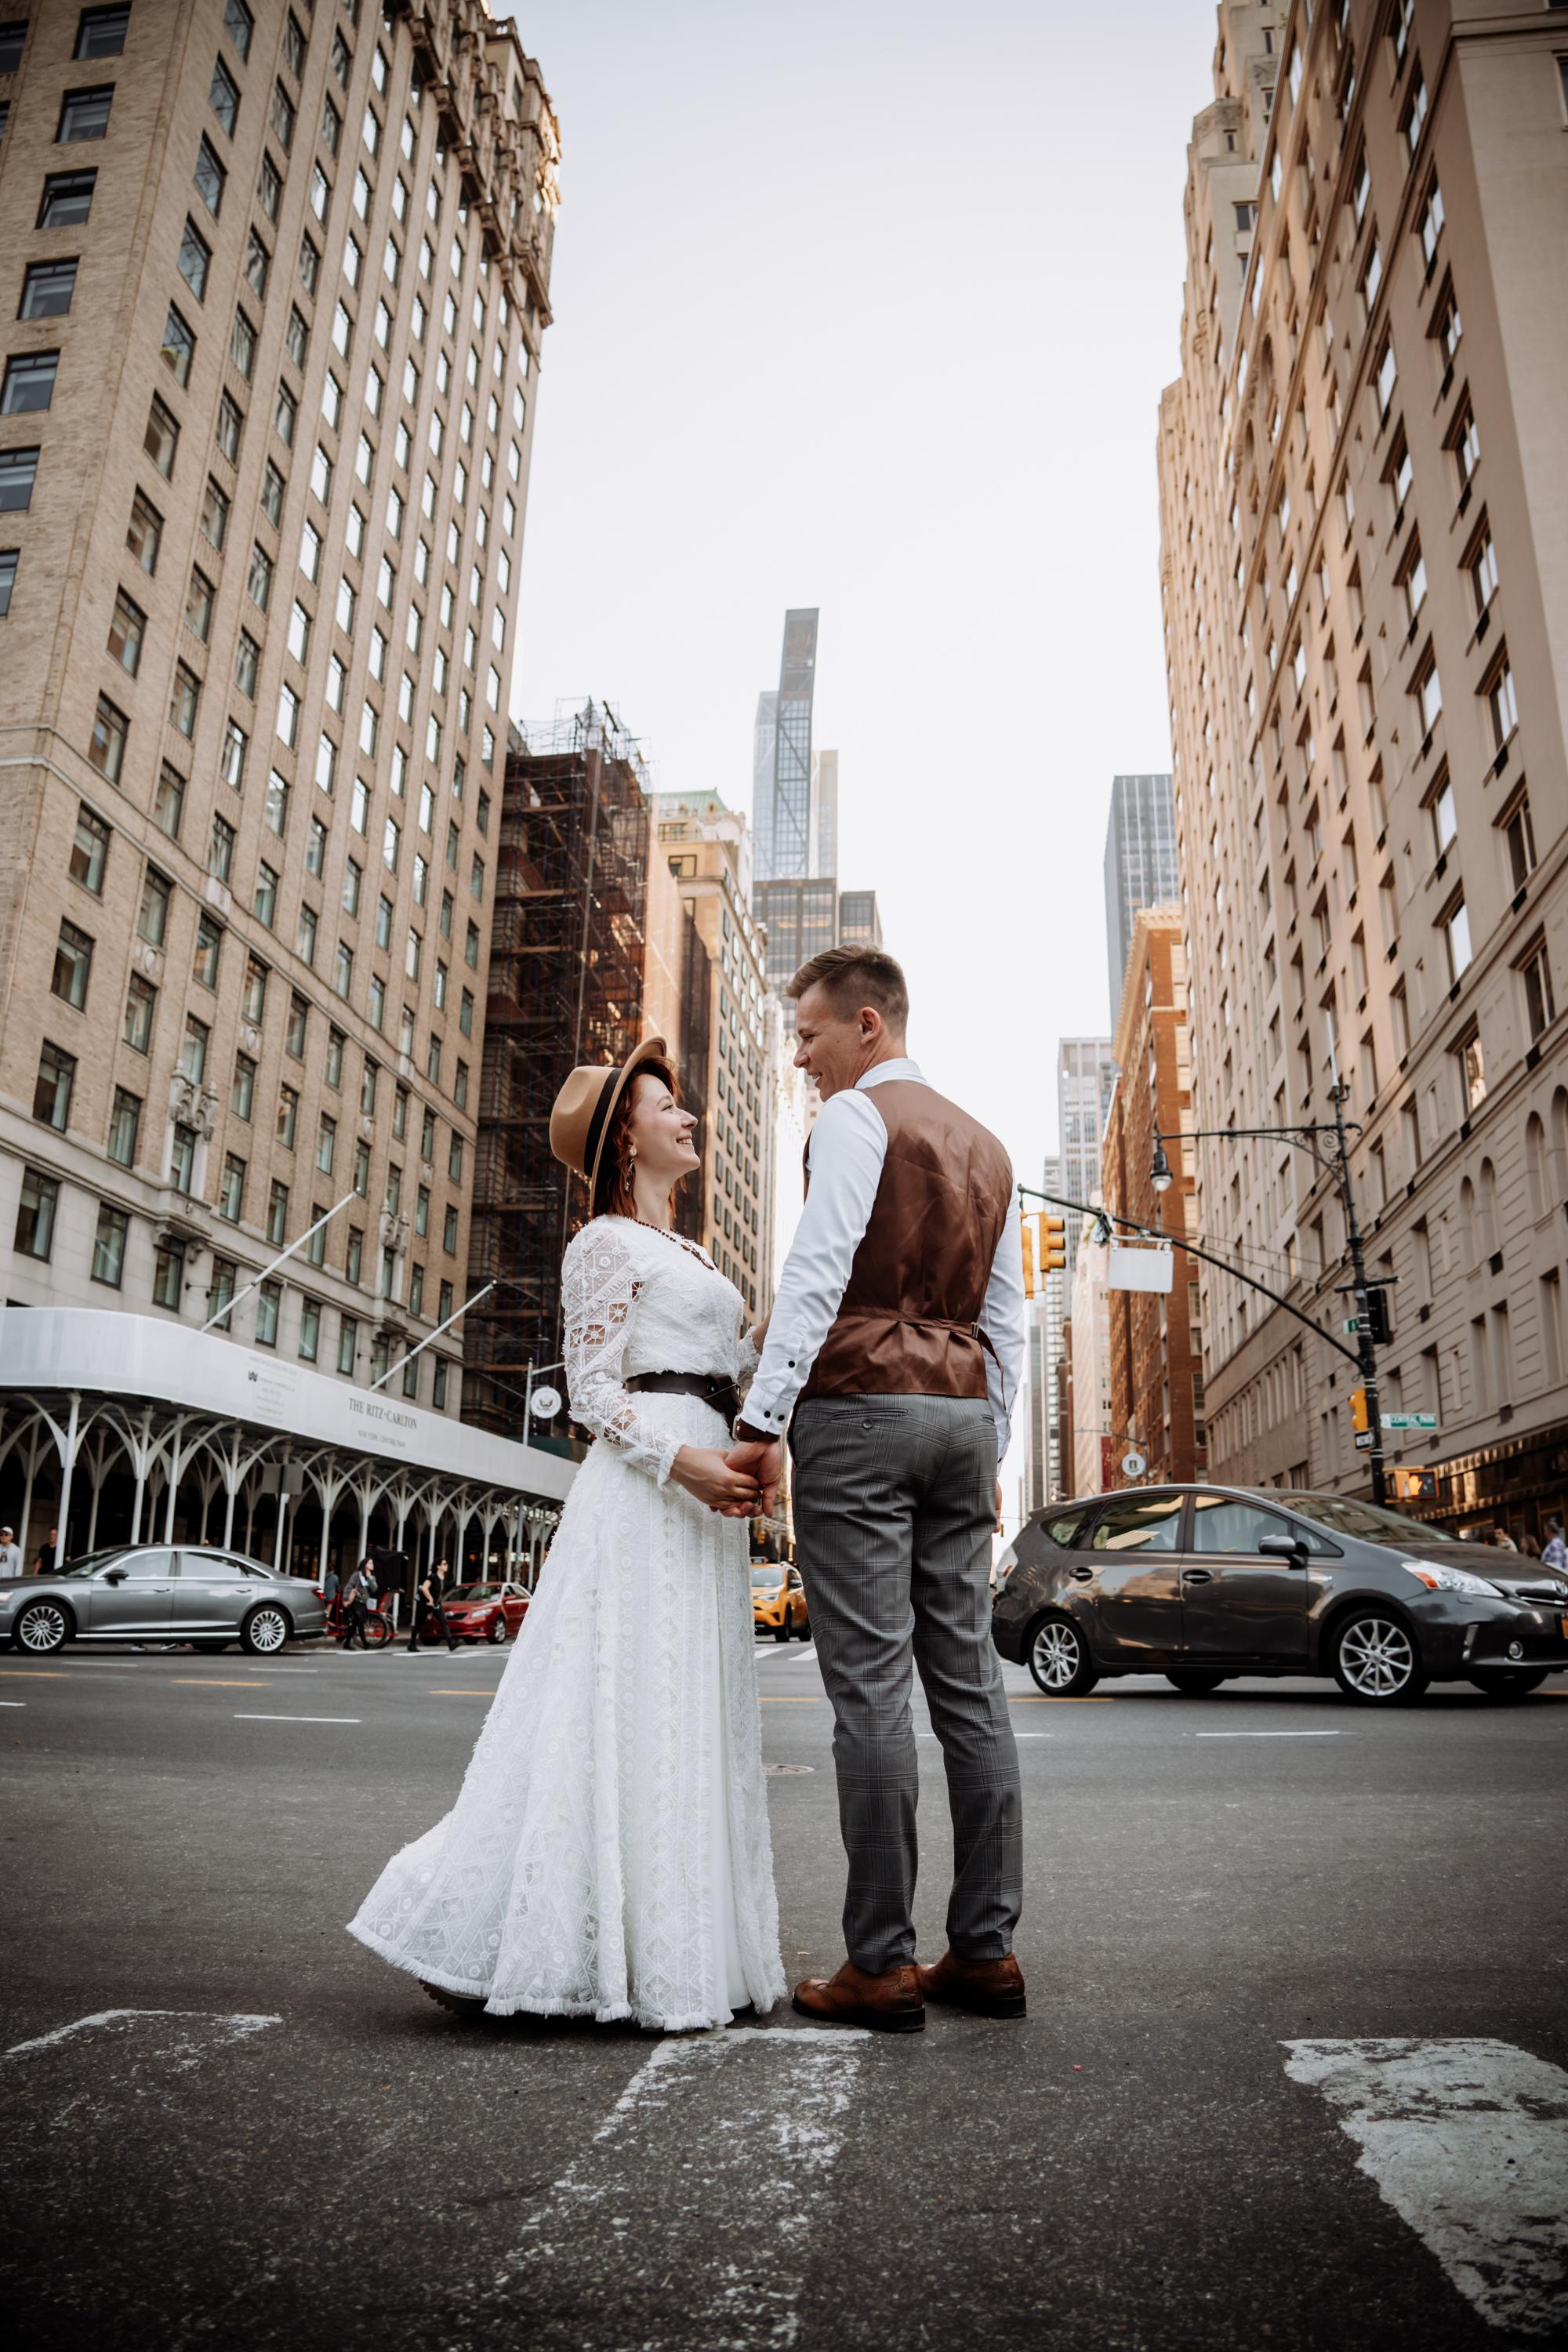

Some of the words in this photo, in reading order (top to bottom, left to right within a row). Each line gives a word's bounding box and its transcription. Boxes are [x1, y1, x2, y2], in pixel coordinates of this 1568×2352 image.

[348, 1397, 364, 1414] THE
[1390, 1414, 1417, 1423] CENTRAL
[1420, 1414, 1436, 1423] PARK
